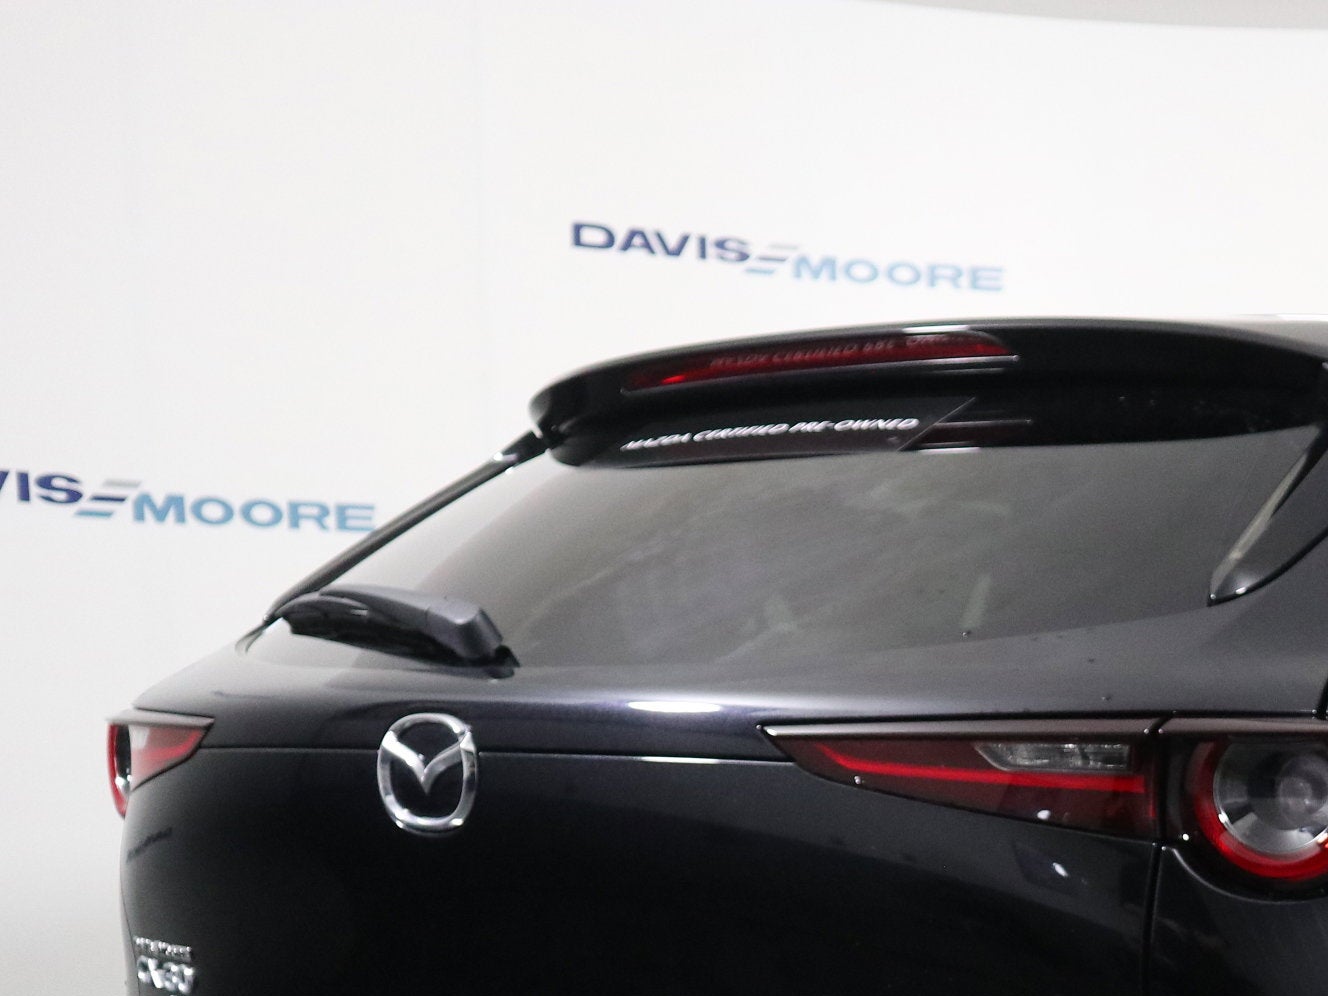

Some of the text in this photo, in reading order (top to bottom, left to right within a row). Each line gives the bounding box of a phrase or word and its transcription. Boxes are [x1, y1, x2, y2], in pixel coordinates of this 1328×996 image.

[571, 222, 1005, 292] DAVIS MOORE
[132, 491, 376, 533] MOORE
